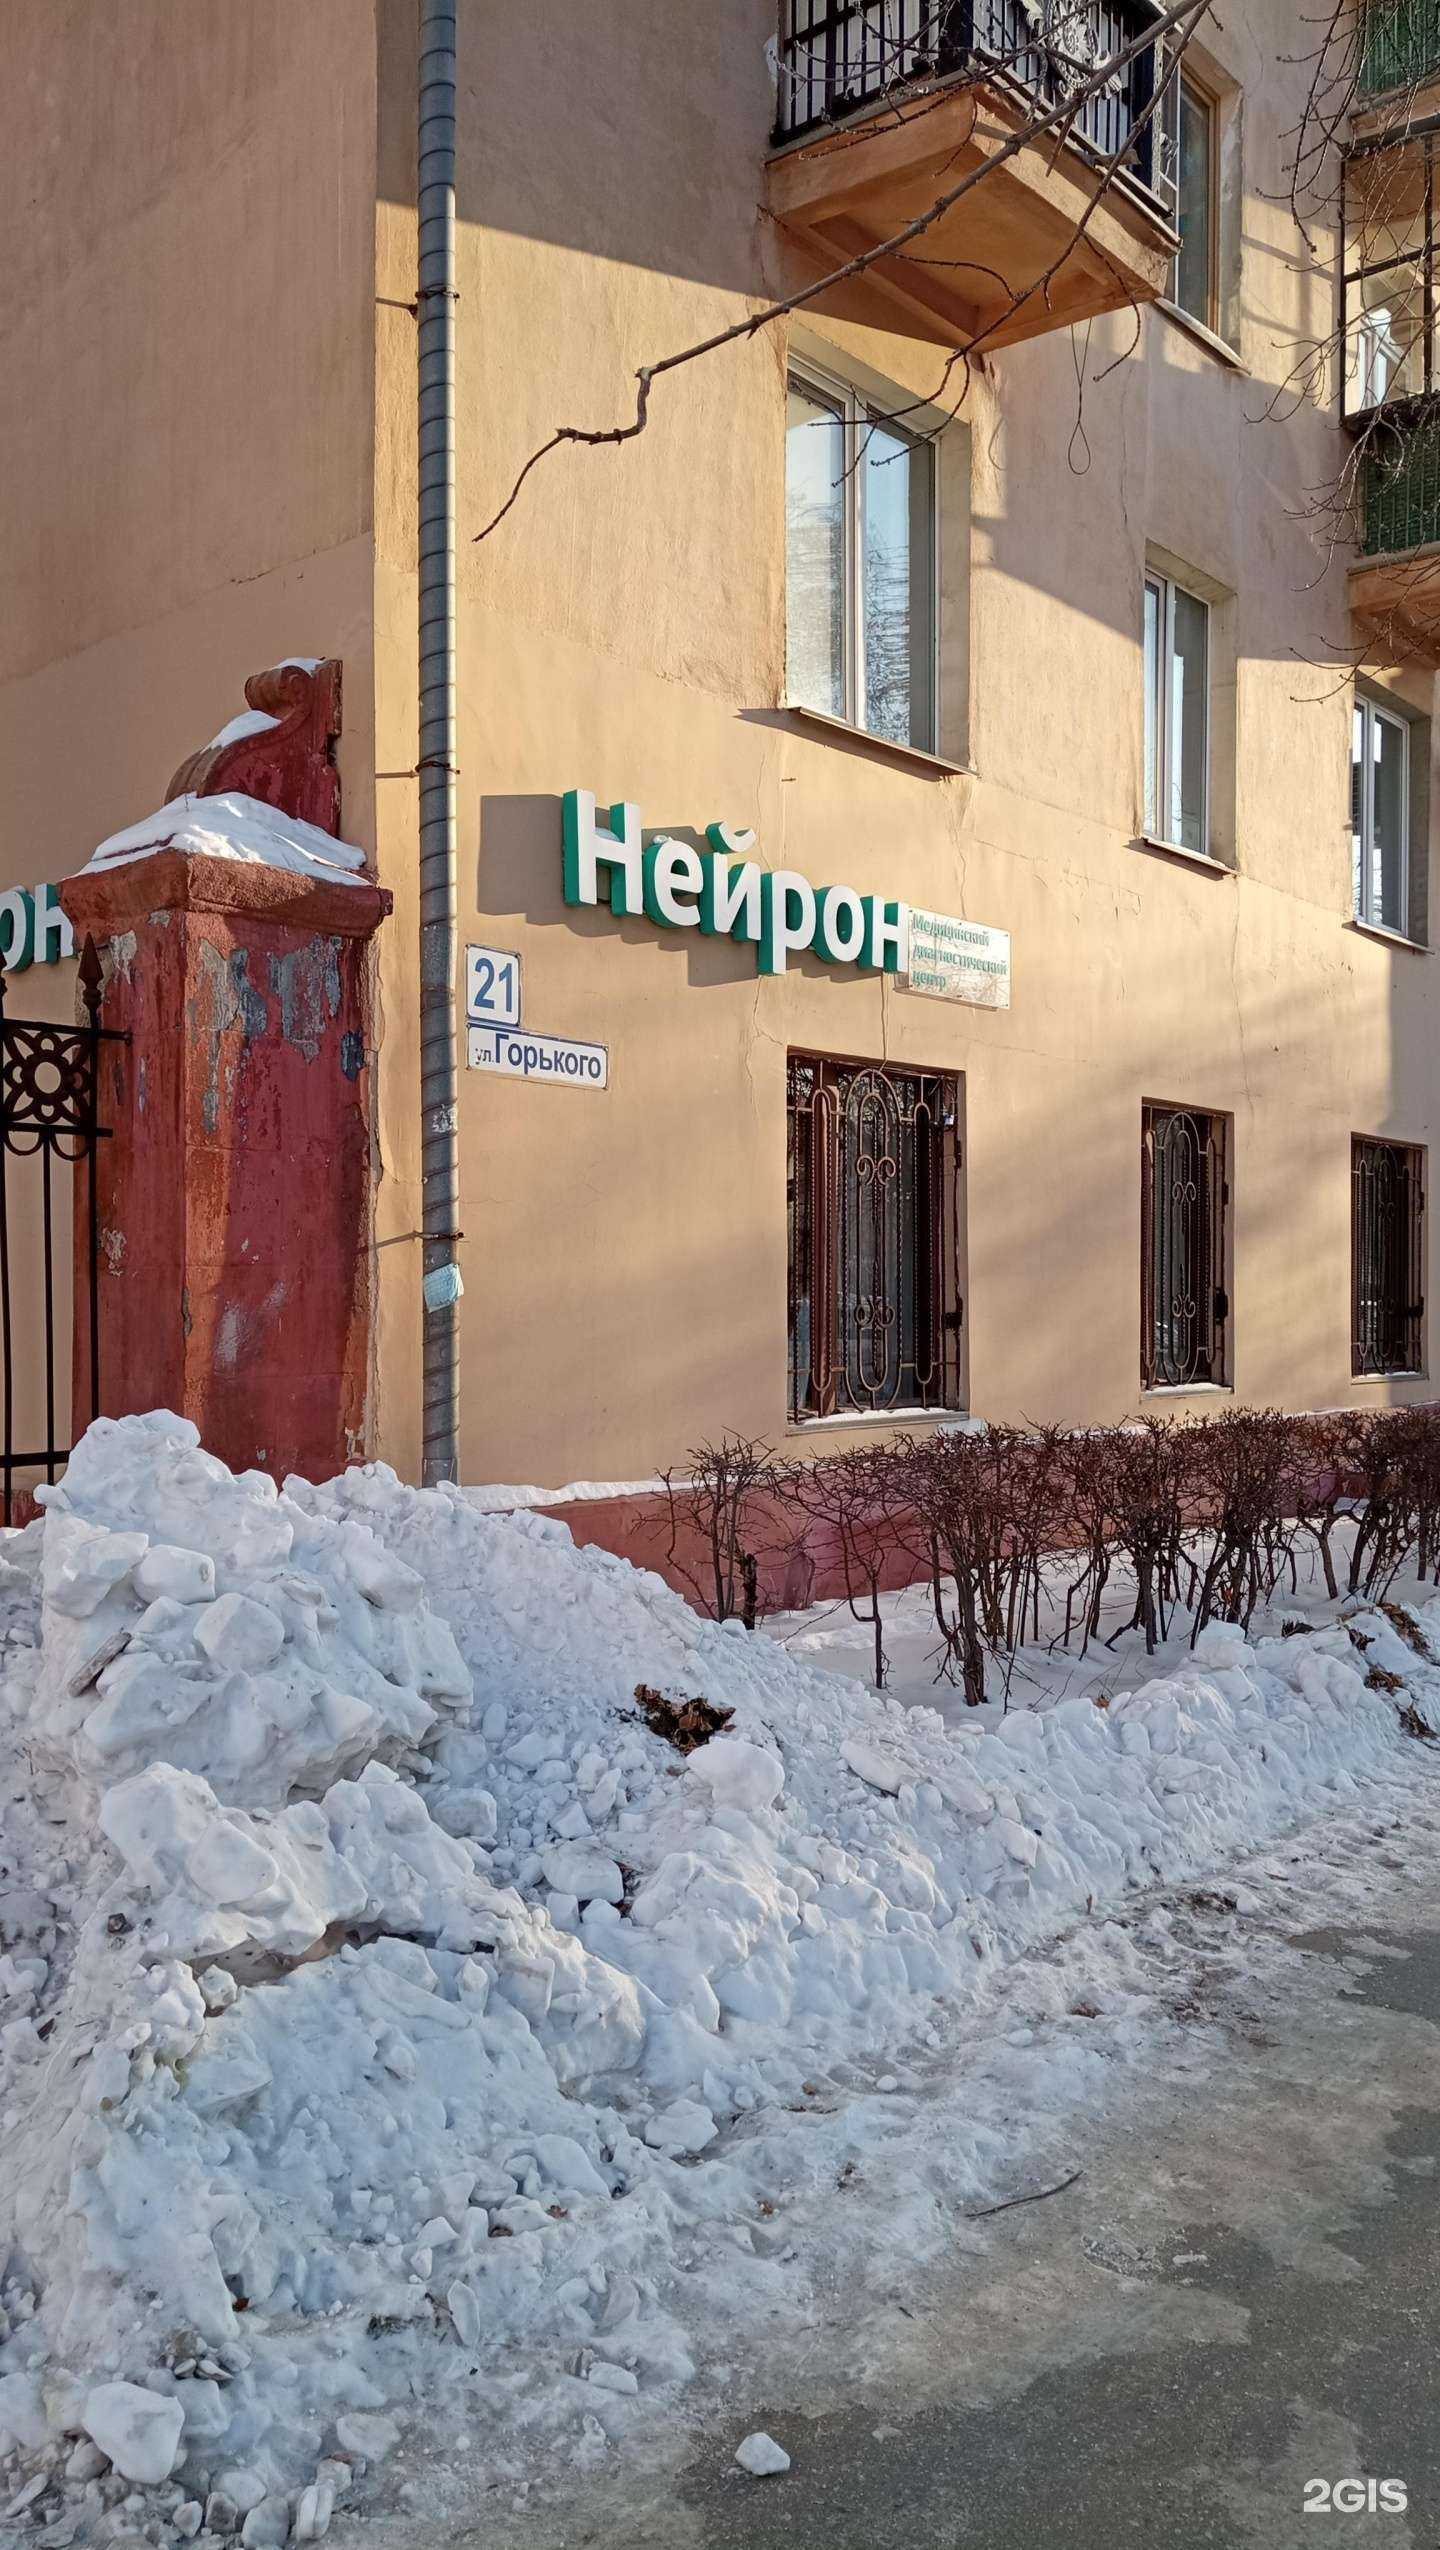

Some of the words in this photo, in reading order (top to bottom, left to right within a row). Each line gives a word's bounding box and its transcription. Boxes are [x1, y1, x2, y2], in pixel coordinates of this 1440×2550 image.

[564, 788, 909, 976] Нейрон
[912, 913, 990, 947] Медицинский
[912, 943, 1009, 976] диагностический
[474, 957, 513, 1013] 21
[912, 970, 947, 992] центр
[495, 1033, 602, 1079] Горького
